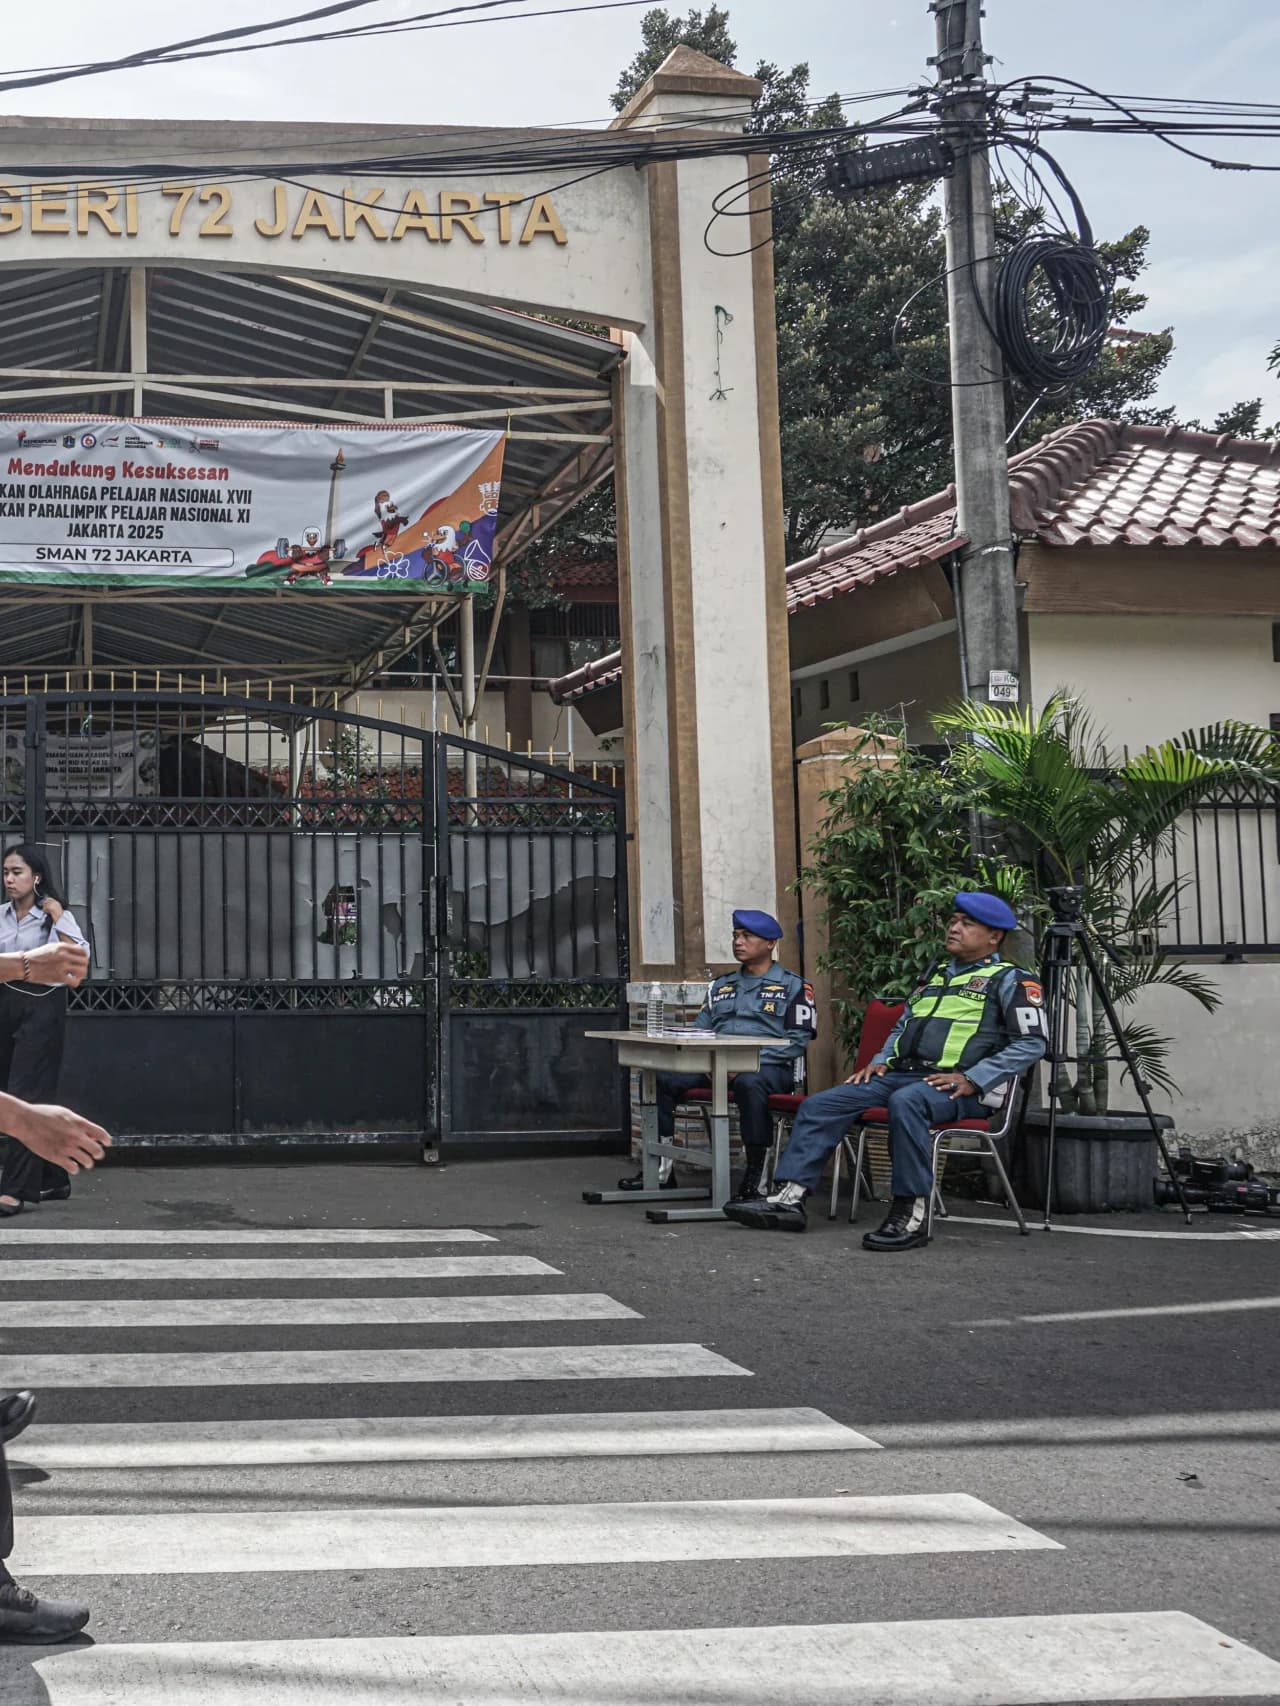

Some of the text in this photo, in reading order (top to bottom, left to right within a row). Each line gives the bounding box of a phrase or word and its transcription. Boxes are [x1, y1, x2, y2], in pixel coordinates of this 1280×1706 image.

[161, 182, 234, 238] 72
[254, 184, 569, 245] JAKARTA
[8, 457, 229, 481] Mendukung Kesuksesan
[28, 484, 97, 501] OLAHRAGA
[100, 486, 157, 502] PELAJAR
[160, 487, 223, 504] NASIONAL
[226, 489, 252, 504] XVII
[28, 503, 107, 519] PARALIMPIK
[111, 505, 167, 521] PELAJAR
[170, 507, 233, 523] NASIONAL
[237, 508, 251, 523] XI
[66, 523, 164, 539] JAKARTA 2025
[36, 547, 193, 563] SMAN 72 JAKARTA
[994, 686, 1010, 697] 049
